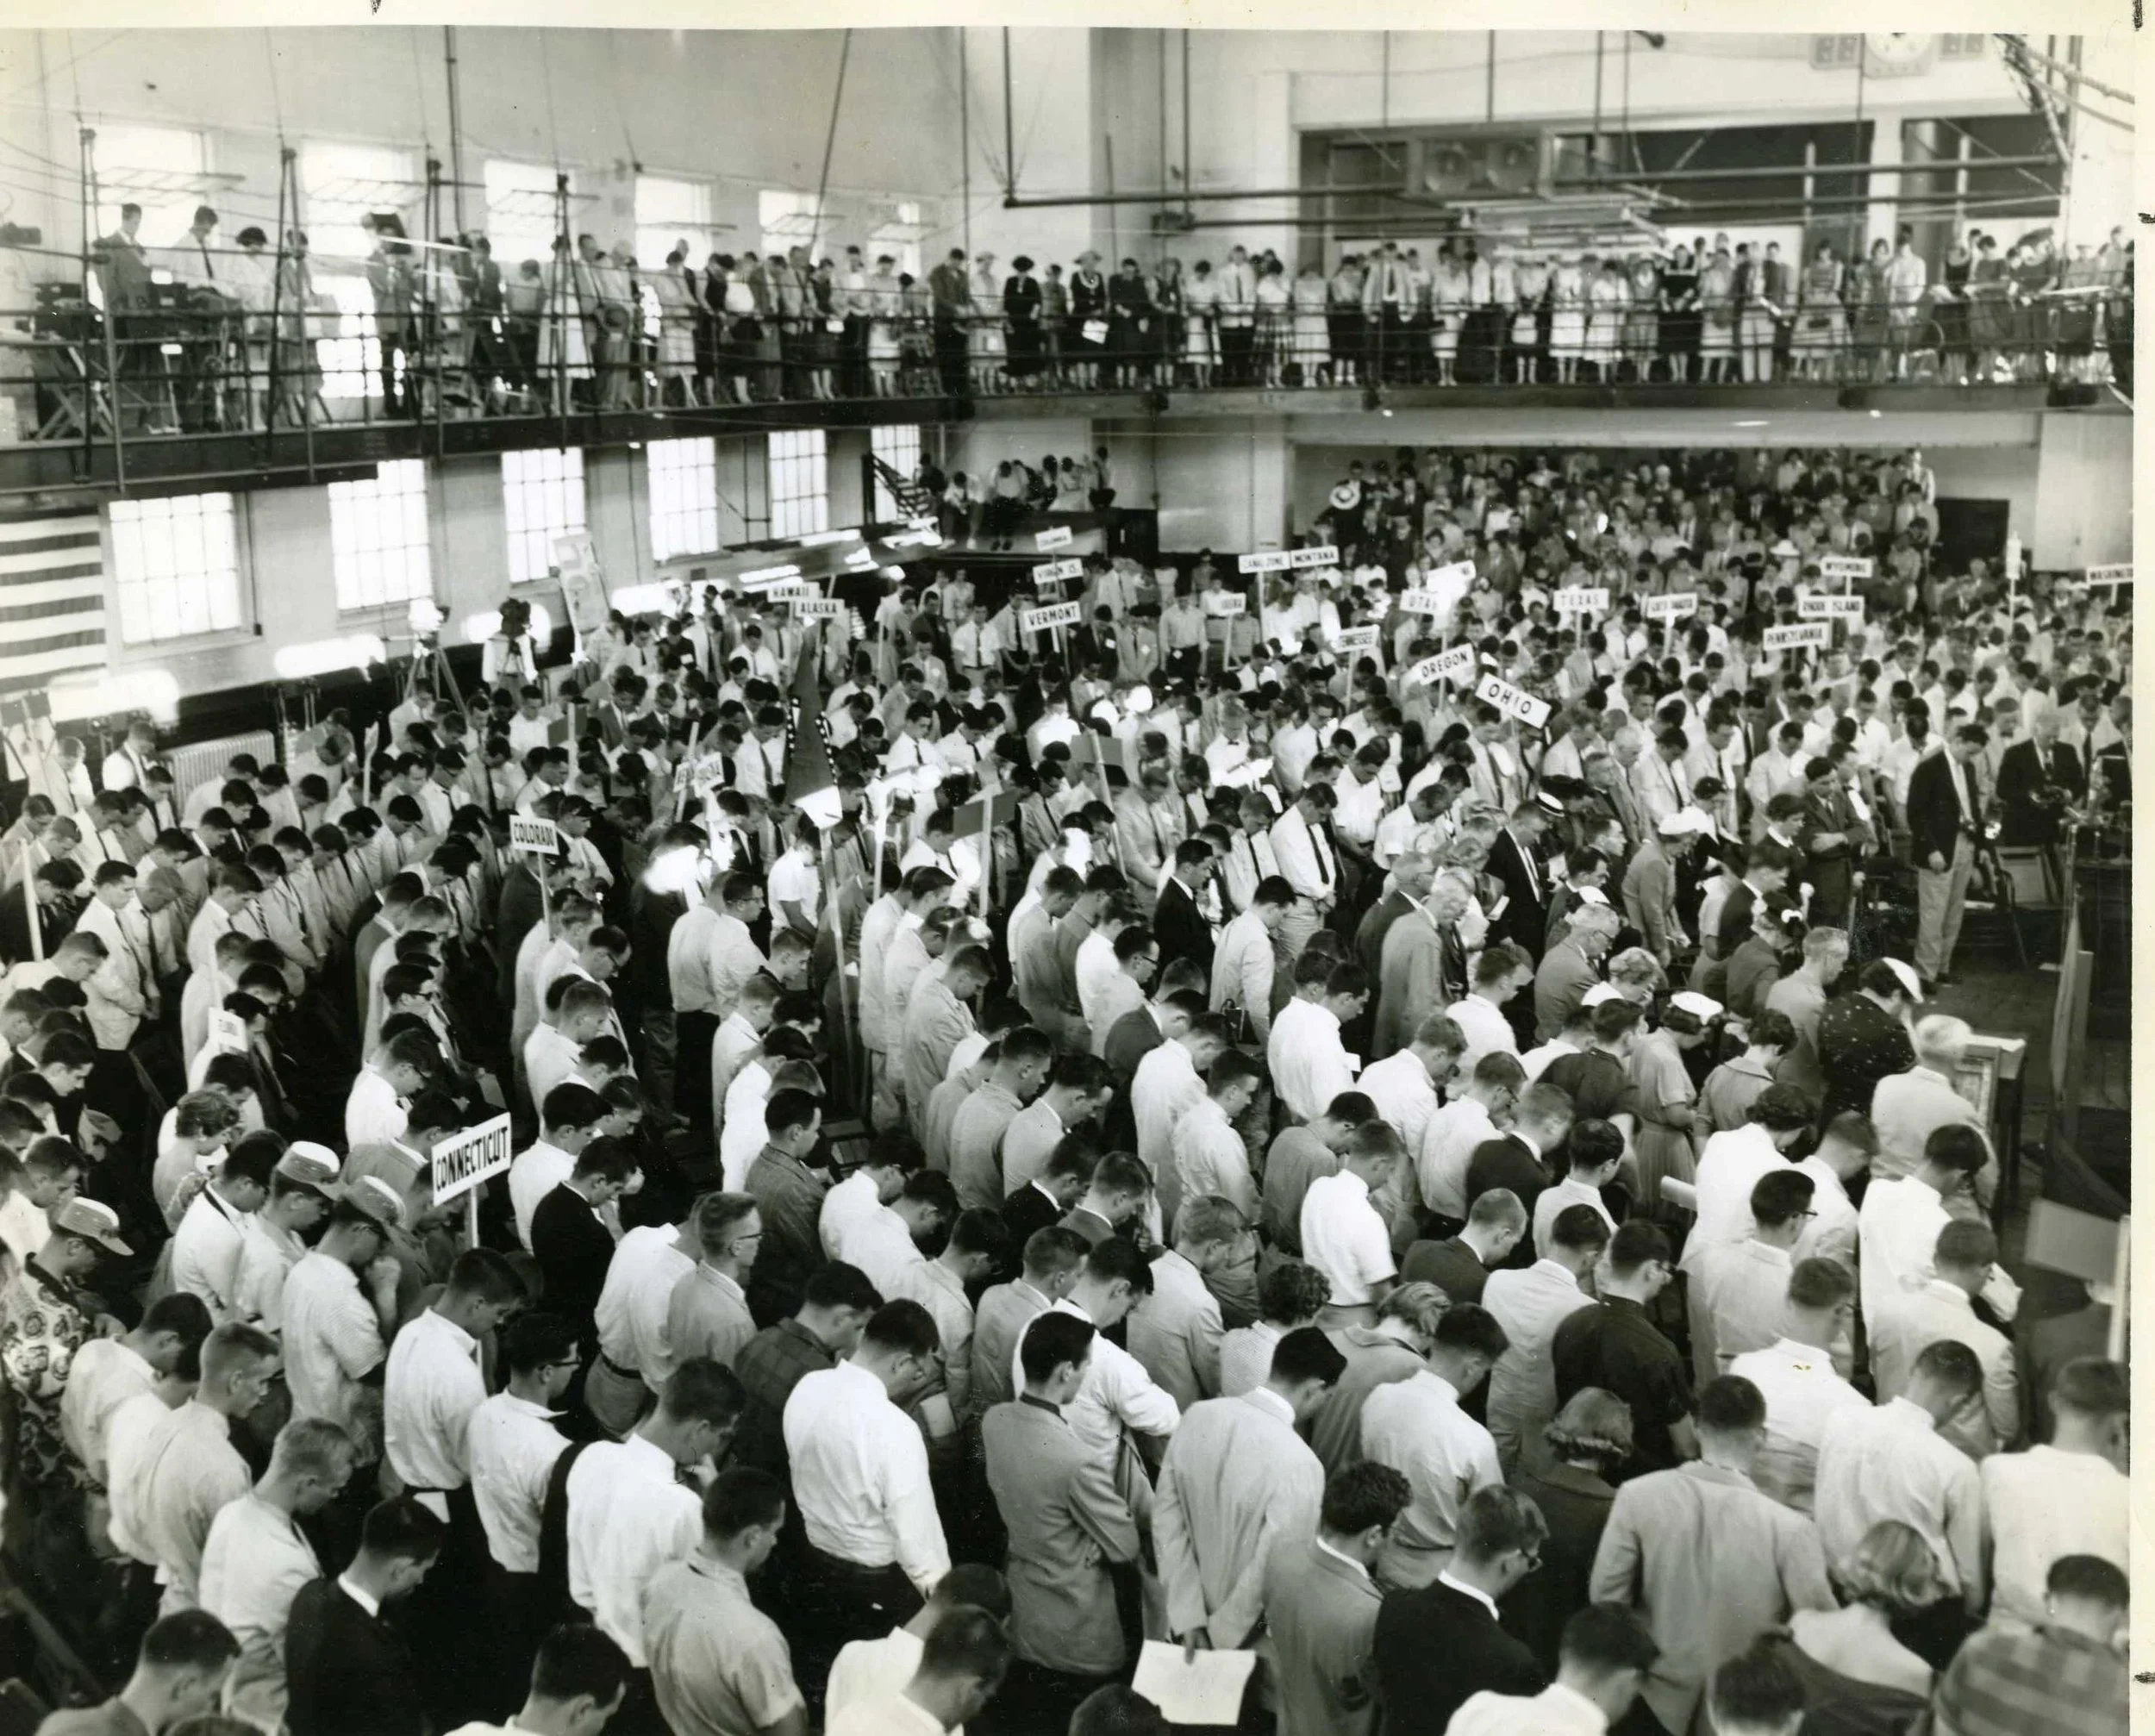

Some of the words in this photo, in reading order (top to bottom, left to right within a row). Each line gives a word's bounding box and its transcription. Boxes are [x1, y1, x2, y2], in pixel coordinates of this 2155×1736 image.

[1294, 551, 1335, 562] MONTANA
[1037, 566, 1064, 579] VIRGN
[773, 587, 809, 597] HAWAII
[1561, 595, 1599, 606] TEXAS
[1833, 601, 1859, 611] ISLAND
[800, 603, 838, 614] ALASKA
[1028, 605, 1077, 626] VERMONT
[1766, 628, 1822, 643] PENNSYLVANIA
[1421, 652, 1468, 678] OREGON
[1488, 684, 1533, 715] OHIO
[436, 1126, 508, 1192] CONNECTICUT
